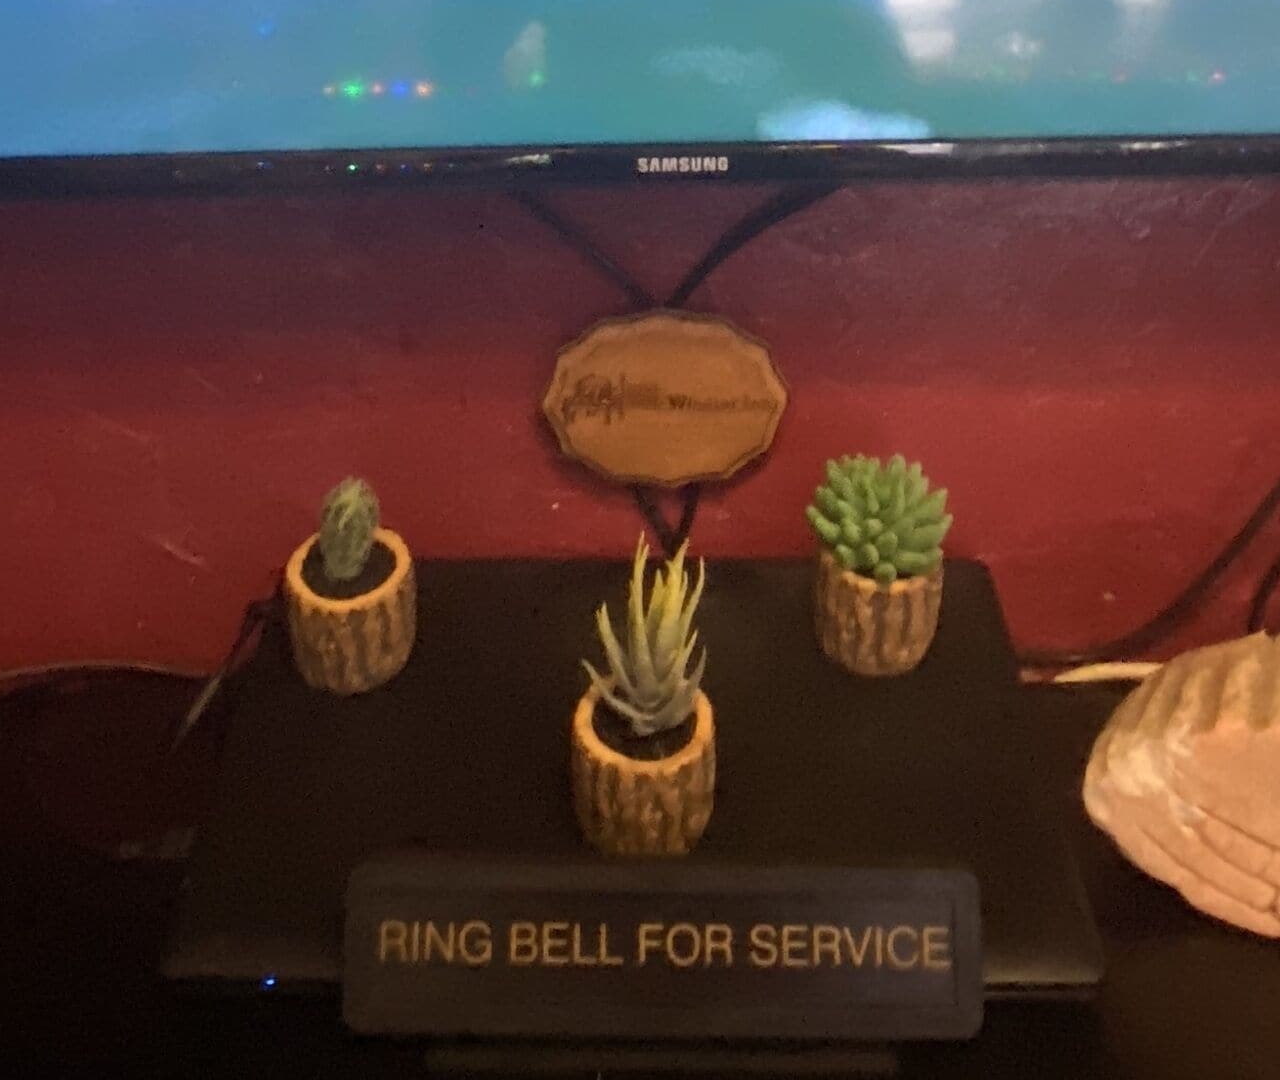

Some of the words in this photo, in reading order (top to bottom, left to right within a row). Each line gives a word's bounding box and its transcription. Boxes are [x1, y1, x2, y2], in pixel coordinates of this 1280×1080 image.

[638, 157, 729, 173] SAMSUNG
[378, 920, 493, 963] RING
[509, 921, 624, 966] BELL
[638, 923, 733, 966] FOR
[749, 925, 952, 969] SERVICE
